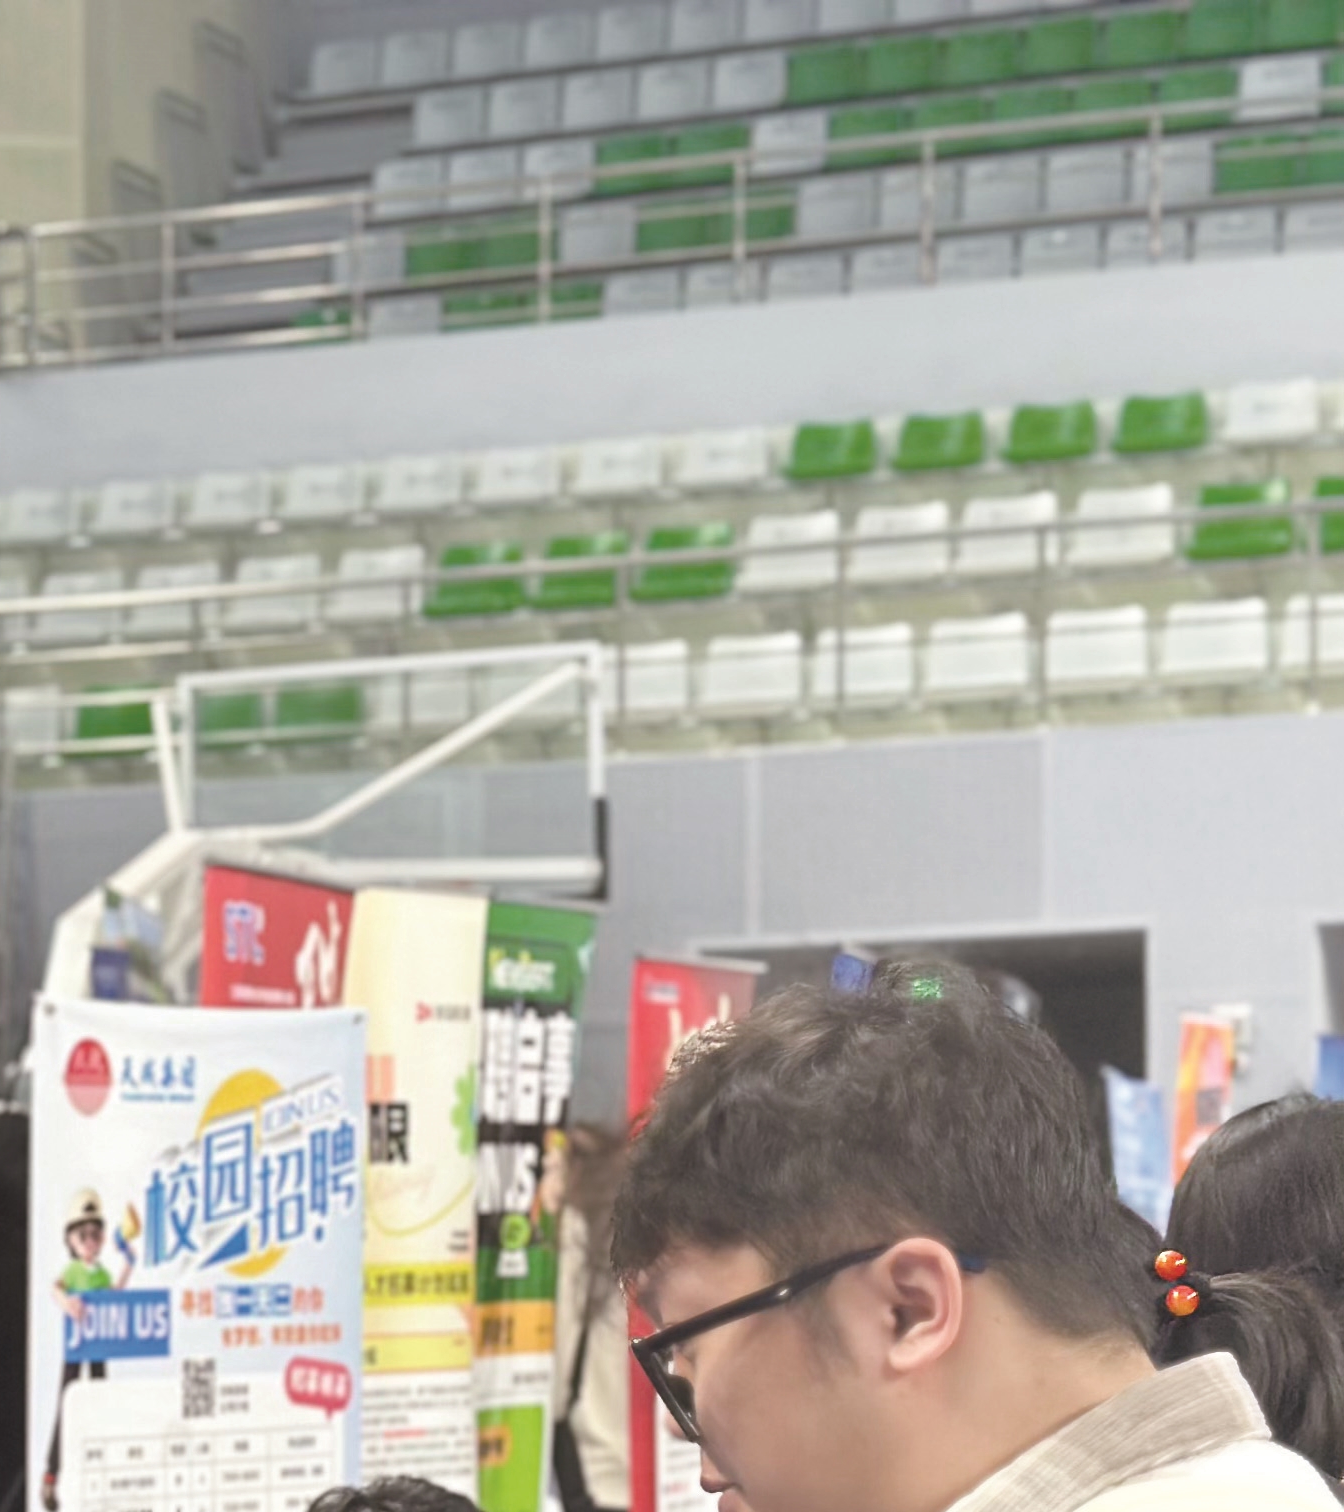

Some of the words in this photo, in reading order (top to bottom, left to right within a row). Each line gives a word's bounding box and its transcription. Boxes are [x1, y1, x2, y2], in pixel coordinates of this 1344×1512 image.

[143, 1117, 357, 1270] 校园招聘
[67, 1304, 129, 1350] JOIN
[135, 1303, 170, 1340] US
